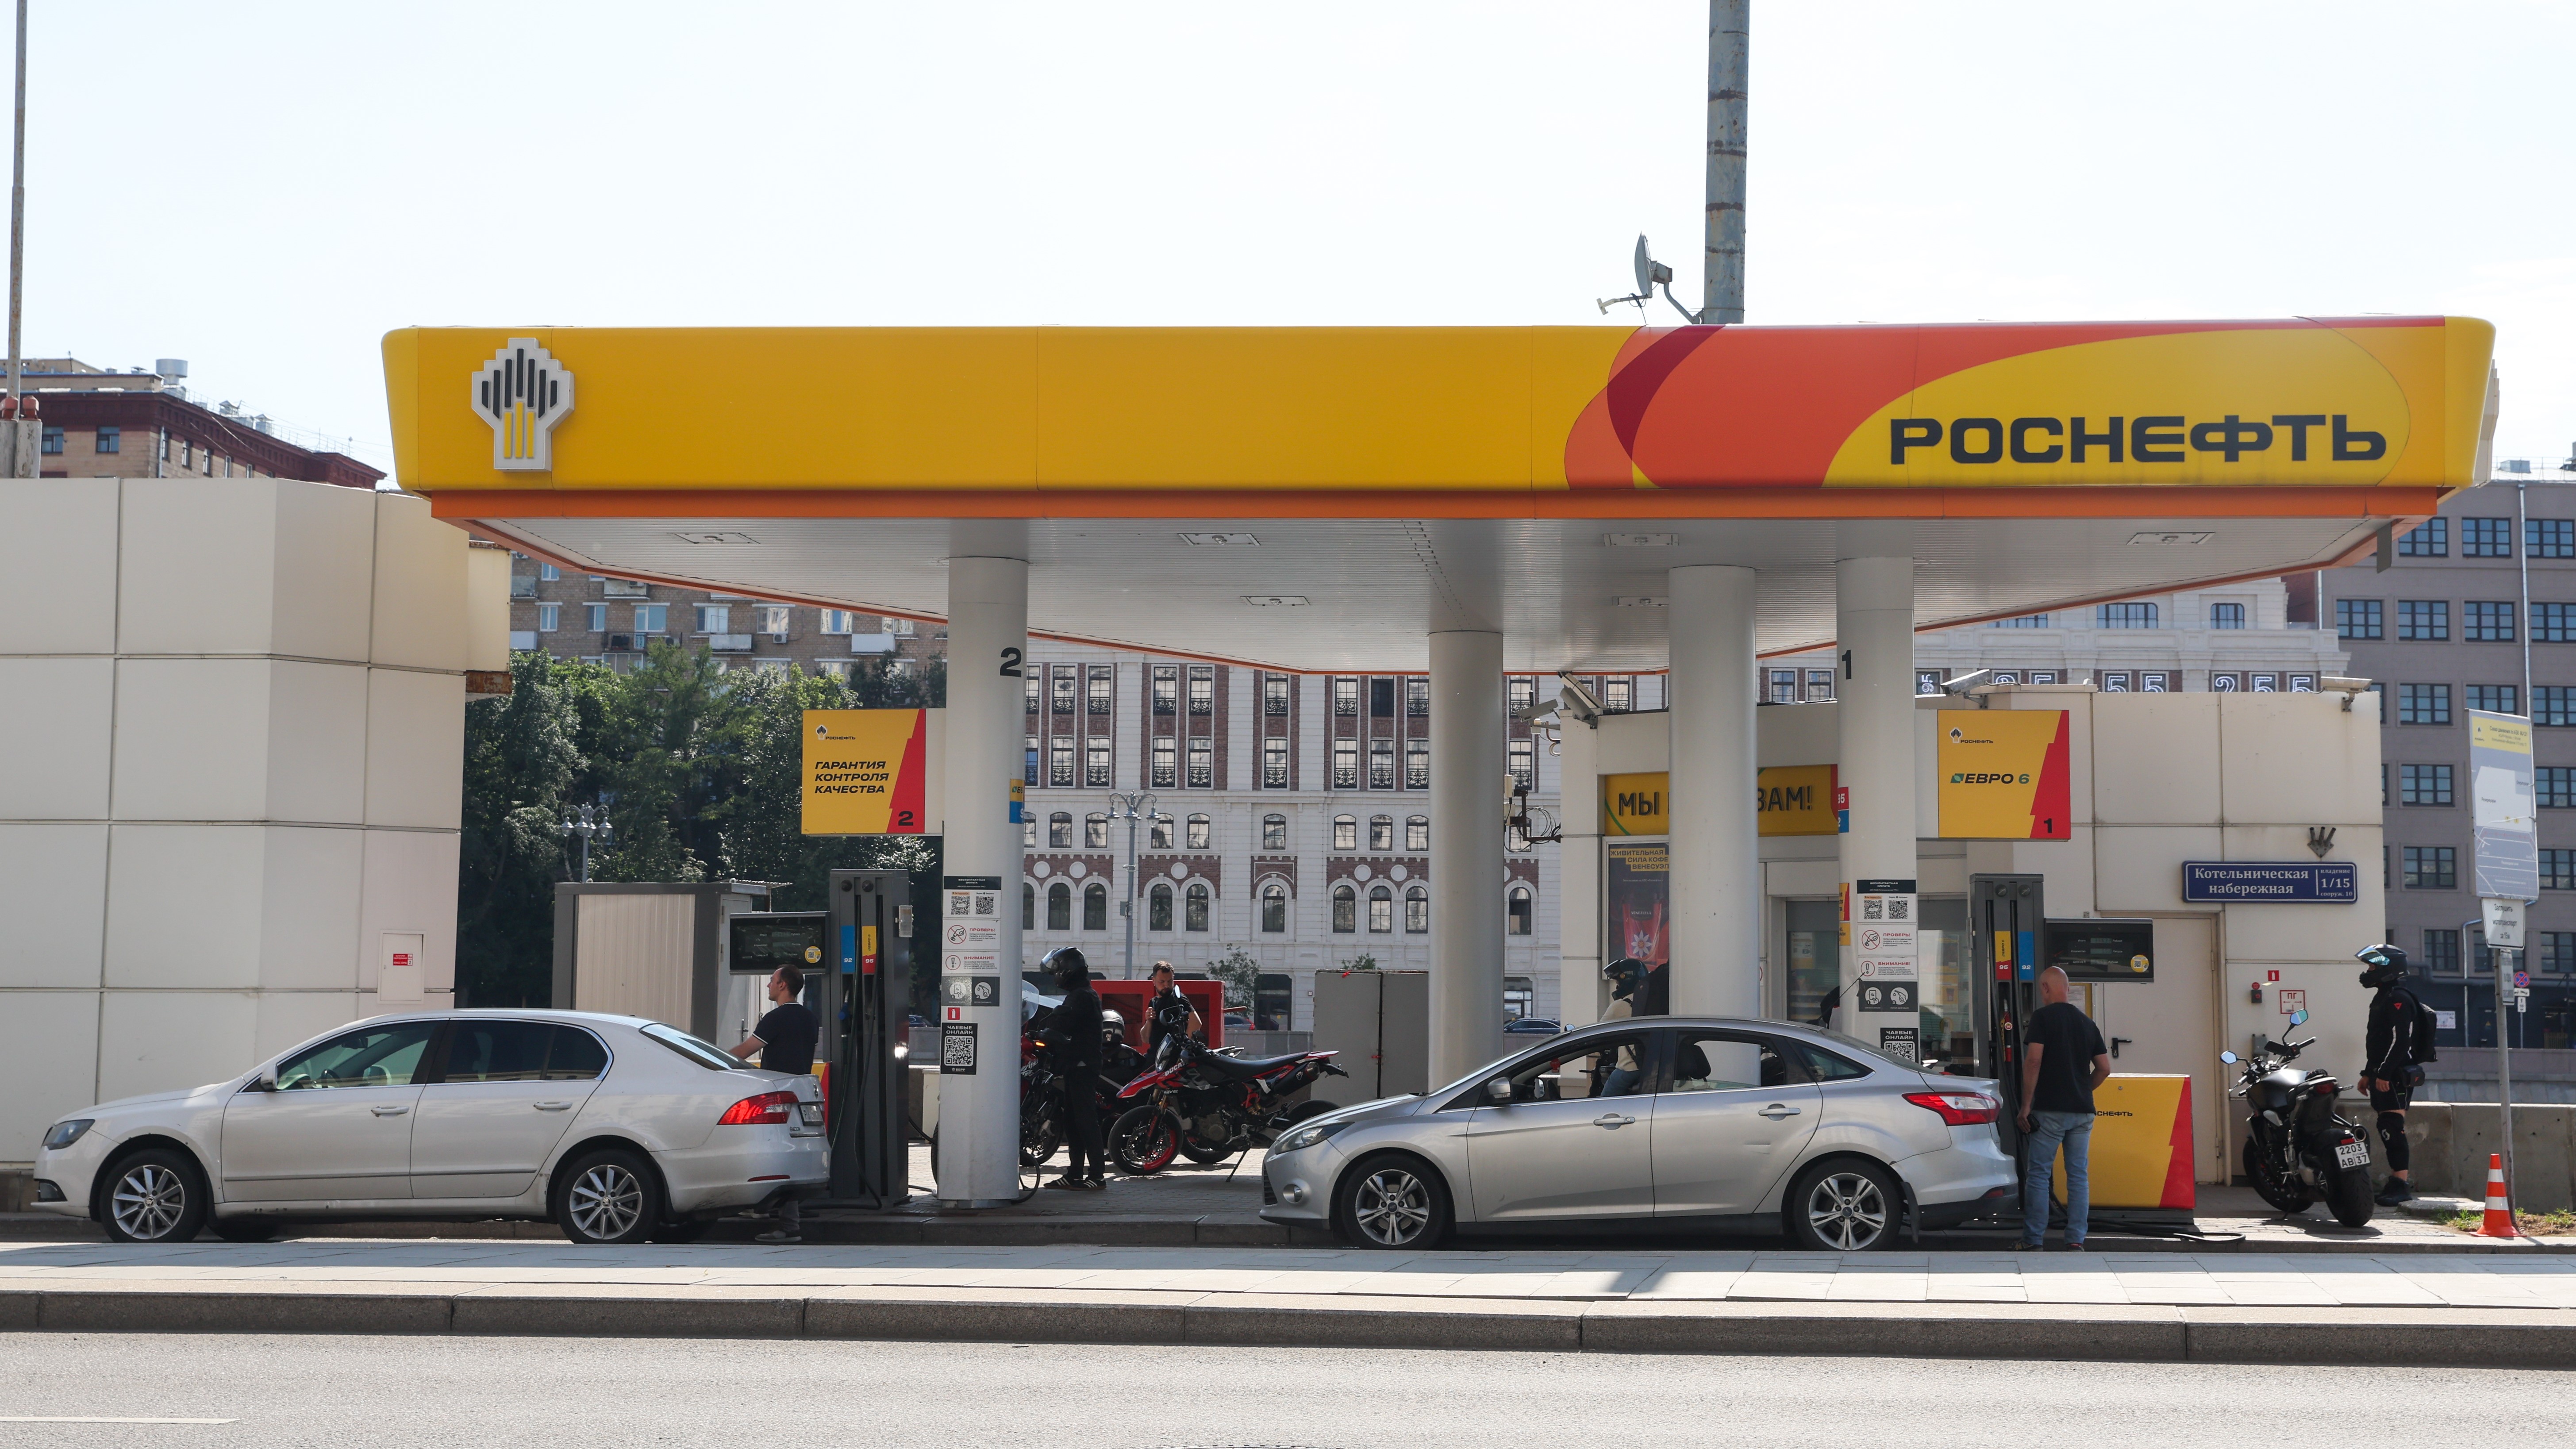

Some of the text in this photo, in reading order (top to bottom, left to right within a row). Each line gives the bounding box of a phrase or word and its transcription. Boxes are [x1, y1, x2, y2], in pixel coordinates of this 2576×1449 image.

[1890, 414, 2386, 465] РОСНЕФТЬ
[1000, 647, 1022, 677] 2
[1842, 650, 1851, 680] 1
[1965, 773, 2030, 784] ЕВРО 6
[1618, 792, 1659, 816] МЫ
[898, 811, 914, 826] 2
[2044, 818, 2053, 834] 1
[2195, 868, 2309, 879] Котельническая
[2209, 883, 2293, 896] набережная
[2321, 878, 2350, 888] 1/15
[2339, 1144, 2362, 1155] 2203
[2356, 1155, 2367, 1164] 37
